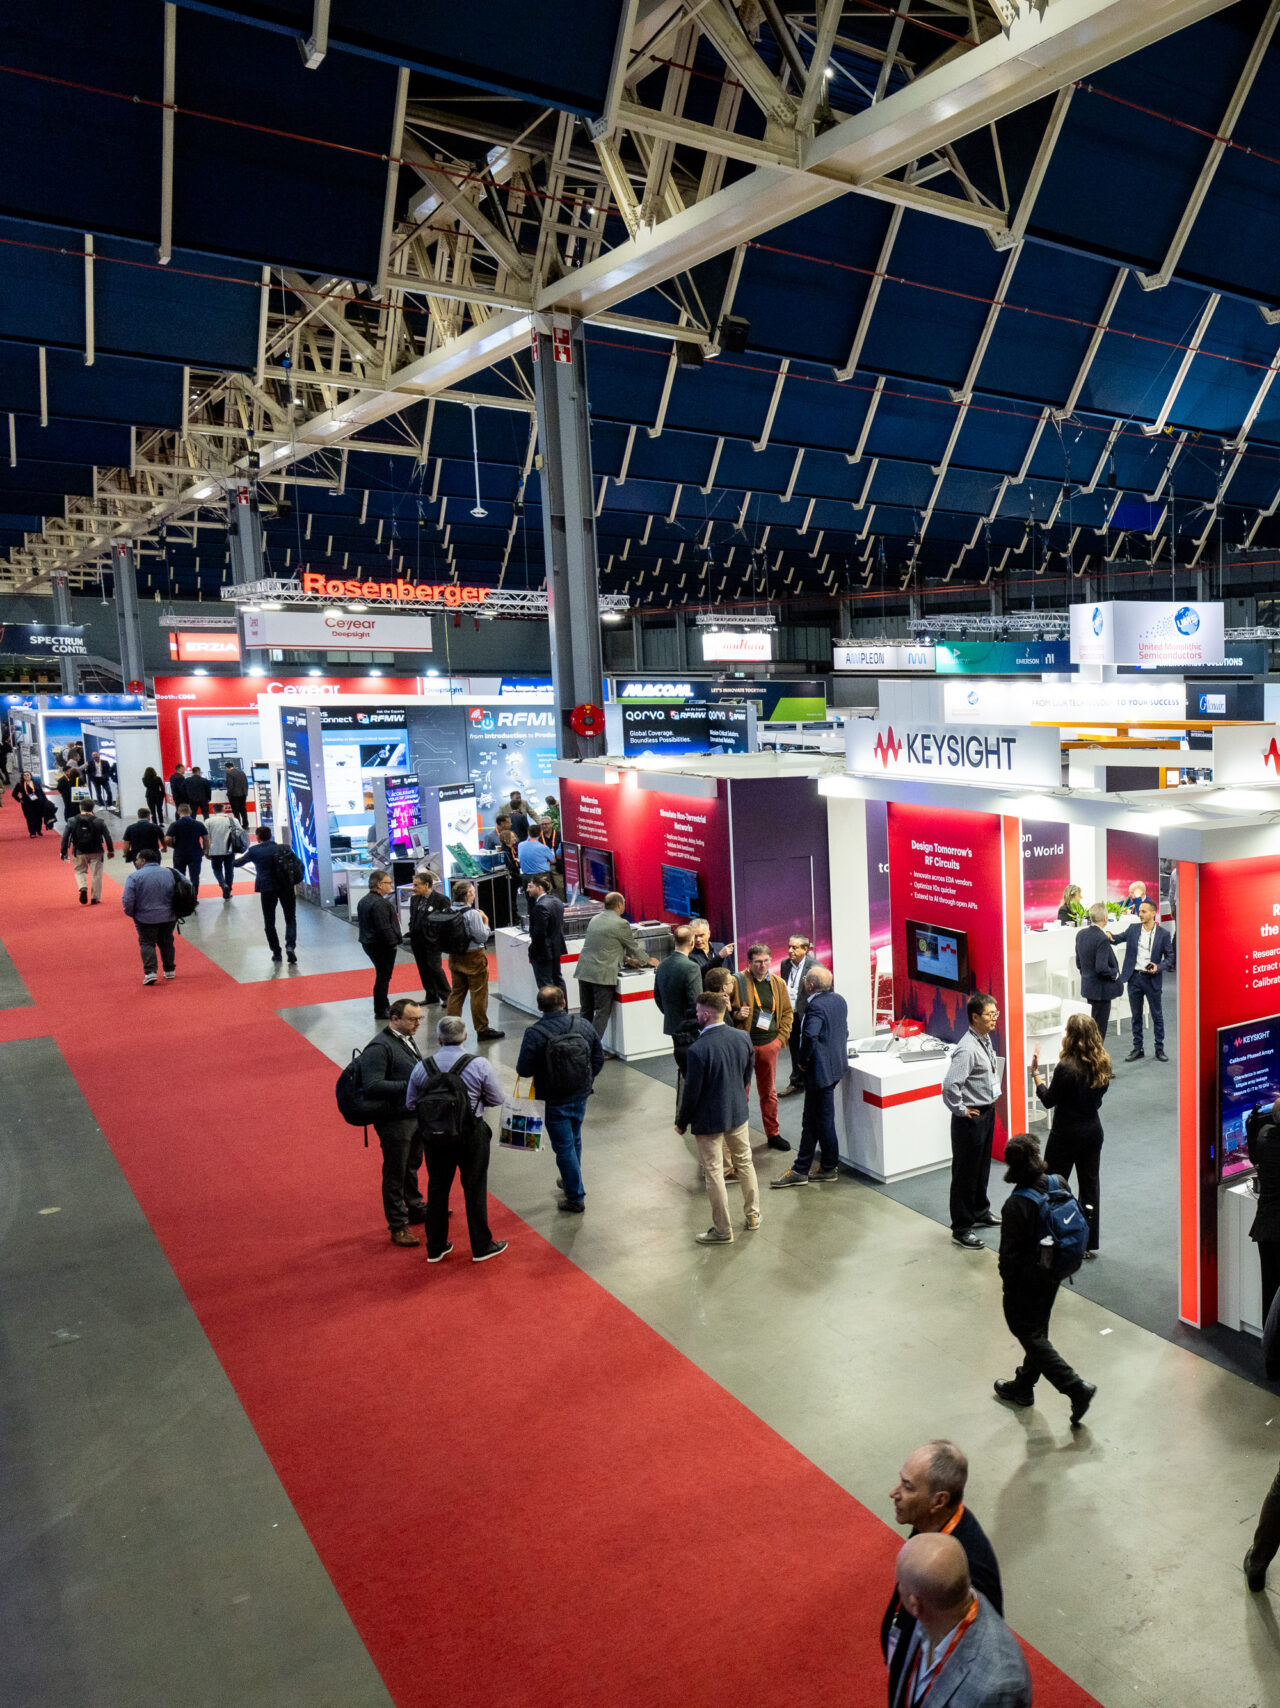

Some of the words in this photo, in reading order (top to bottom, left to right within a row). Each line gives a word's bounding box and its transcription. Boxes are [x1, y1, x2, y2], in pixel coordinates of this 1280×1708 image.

[303, 572, 490, 607] Rosenberger
[324, 617, 376, 630] Ceyear
[1176, 613, 1199, 628] UMS
[29, 636, 84, 646] SPECTRUM
[331, 631, 371, 639] Deepsight
[1138, 642, 1163, 651] United
[1164, 642, 1202, 651] Monolithic
[845, 652, 885, 665] AMPLEON
[1138, 650, 1202, 660] Semiconductors
[370, 714, 405, 723] RFMW
[907, 733, 1016, 770] KEYSIGHT
[911, 840, 934, 854] Design
[934, 843, 973, 858] Tomorrow's
[1034, 844, 1064, 858] World
[925, 855, 934, 866] RF
[934, 857, 960, 870] Circuits
[913, 870, 932, 880] Innovate
[931, 874, 945, 882] across
[945, 876, 955, 884] EDA
[955, 878, 973, 887] vendors
[913, 881, 932, 890] Optimize
[940, 886, 957, 895] quicker
[914, 891, 929, 900] Extend
[938, 896, 956, 907] through
[967, 902, 978, 910] APIs
[1260, 923, 1279, 937] the
[1252, 961, 1278, 974] Extract
[1242, 1030, 1271, 1044] KEYSIGHT
